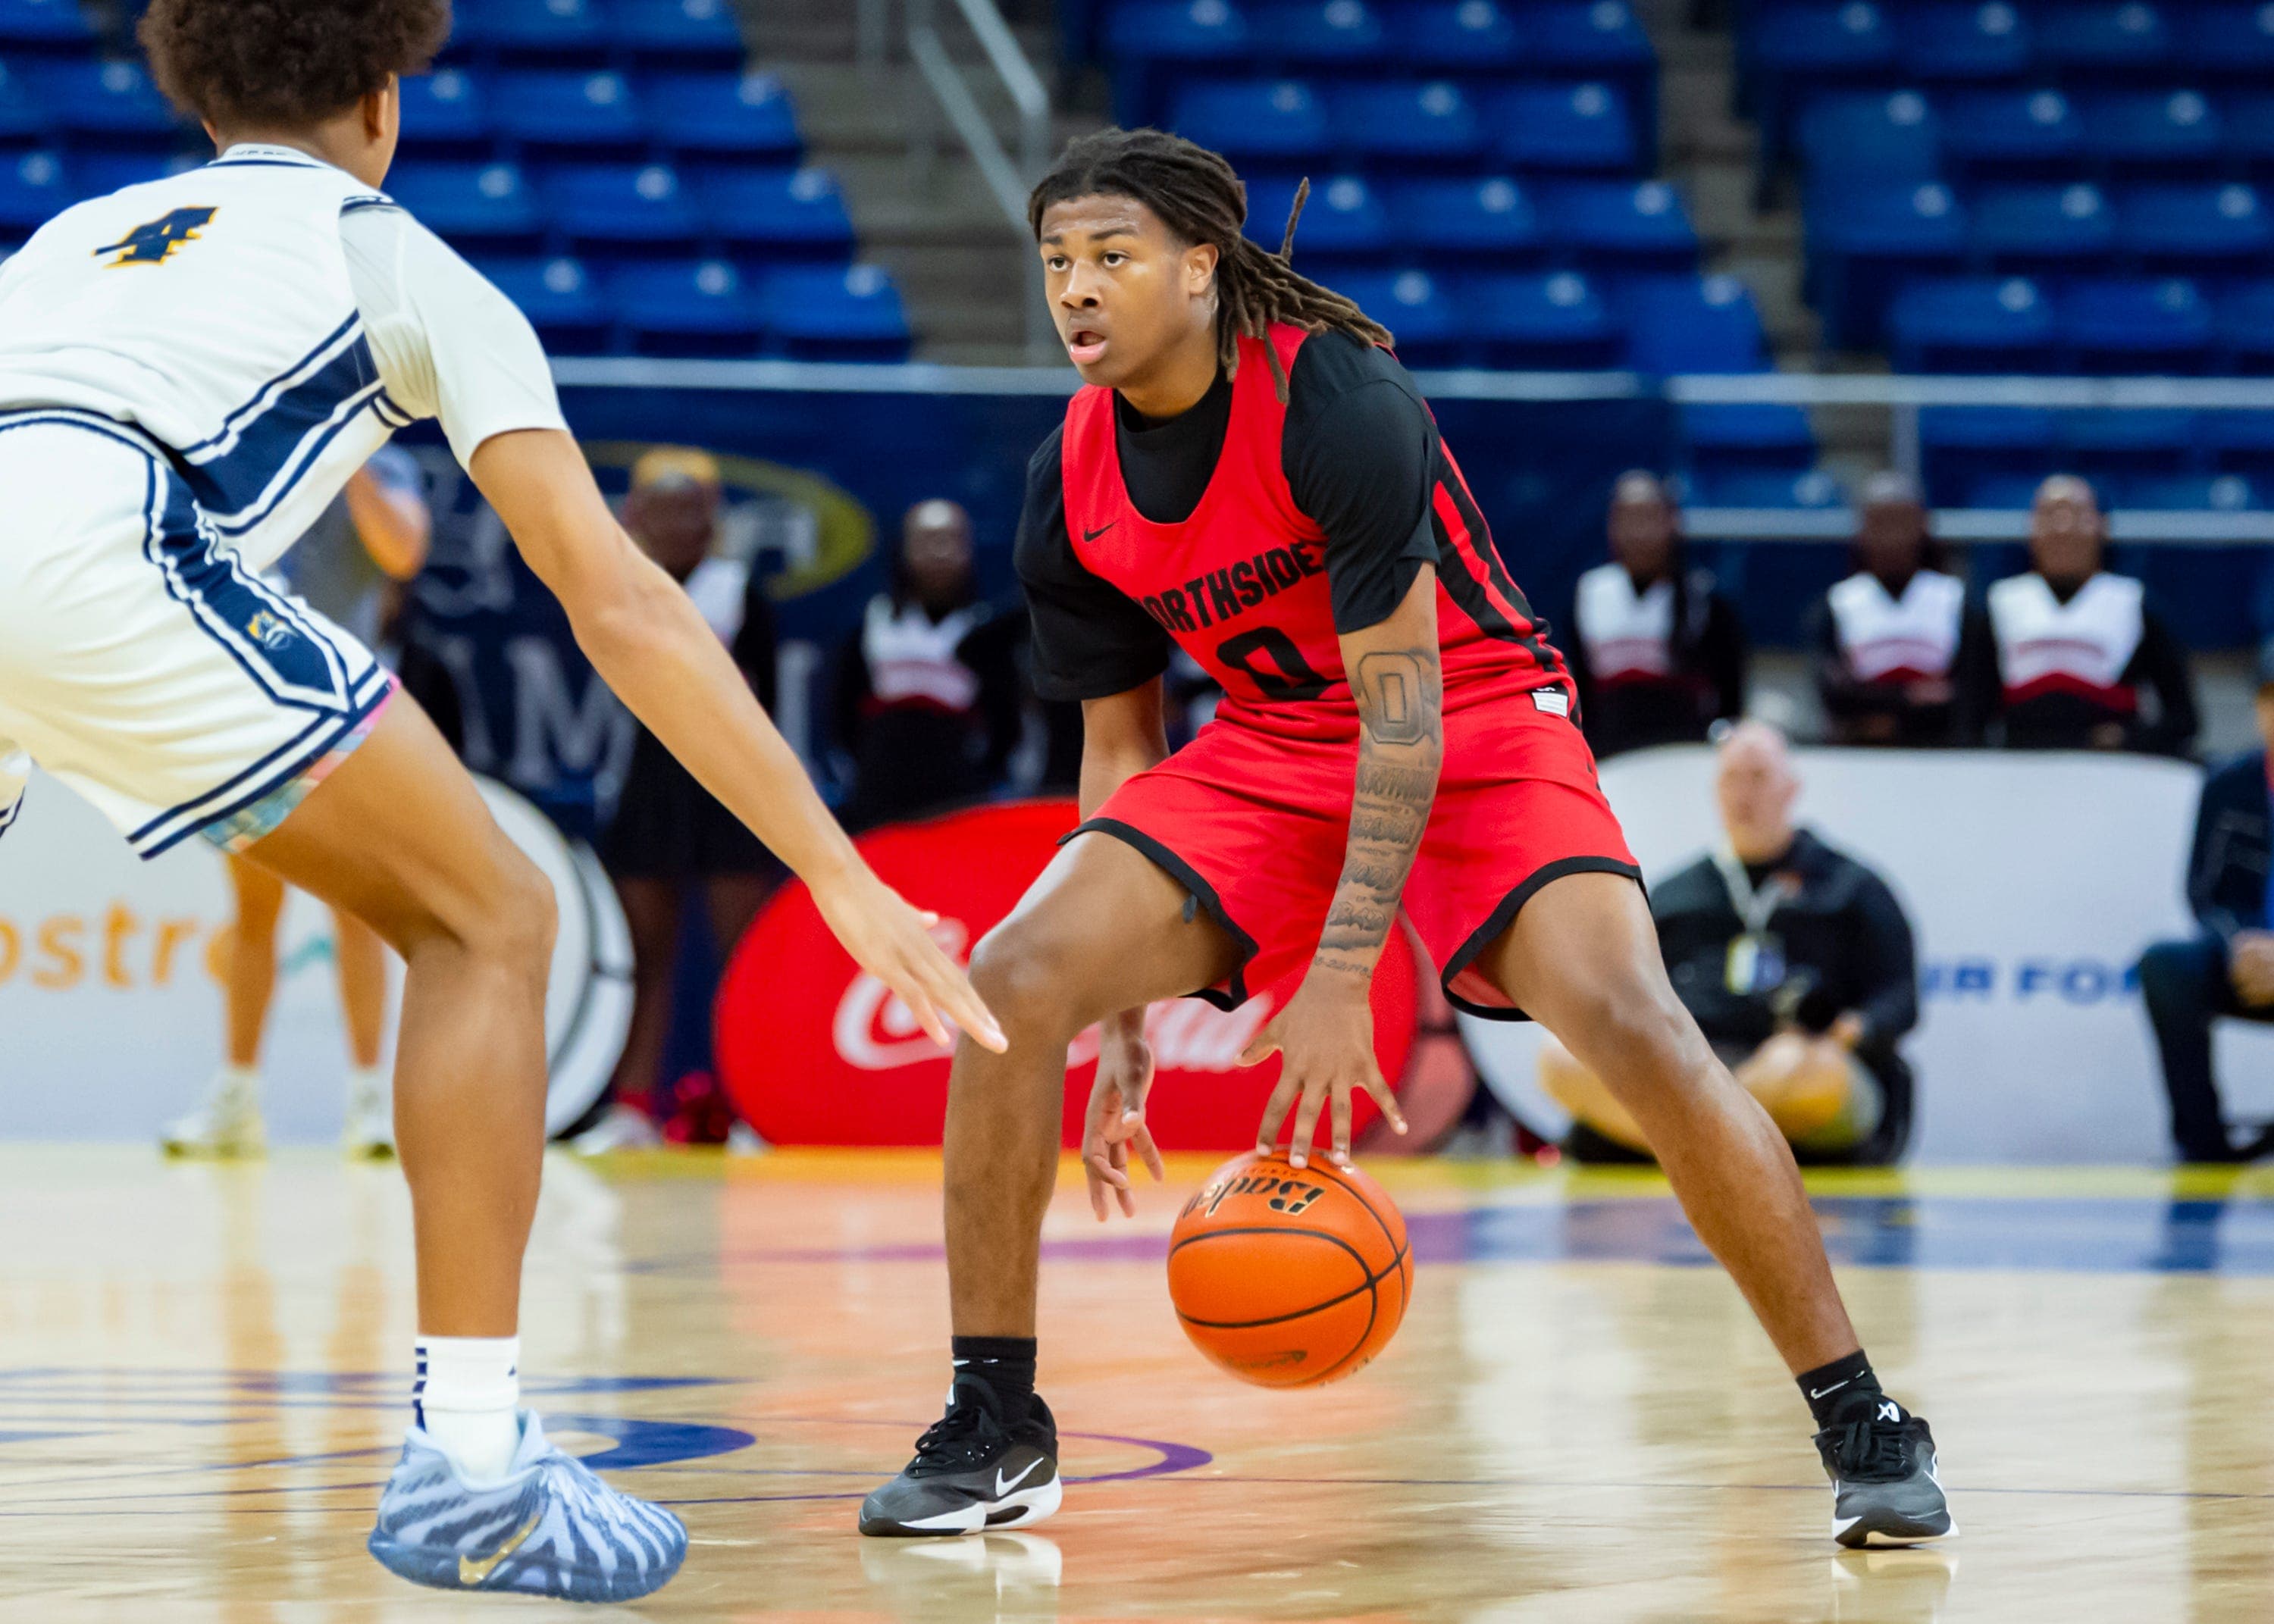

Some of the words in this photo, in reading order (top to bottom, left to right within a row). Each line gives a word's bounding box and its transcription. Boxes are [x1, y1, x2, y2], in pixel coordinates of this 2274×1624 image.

[90, 205, 221, 269] 4
[1132, 542, 1325, 633] ORTHSIDE
[1216, 625, 1331, 702] 0
